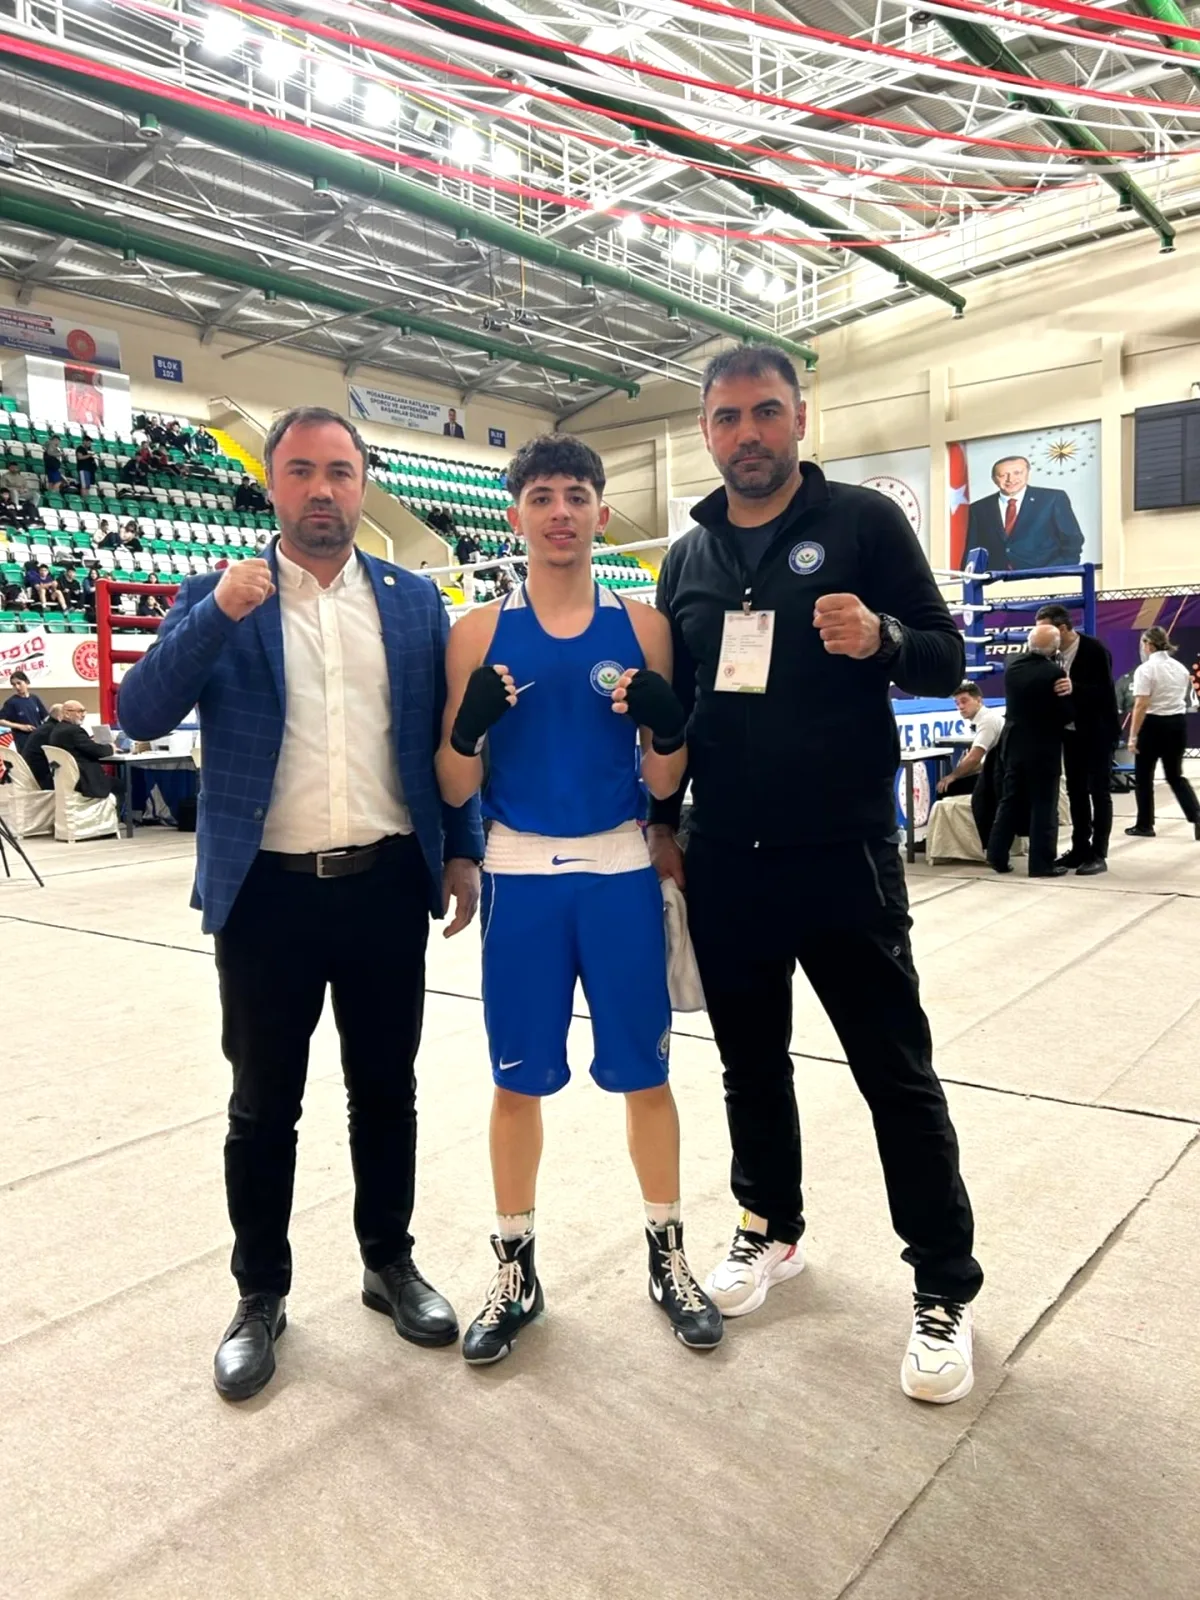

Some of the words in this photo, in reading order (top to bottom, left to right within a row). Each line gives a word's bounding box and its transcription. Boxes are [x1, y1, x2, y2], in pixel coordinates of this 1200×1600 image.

[157, 359, 178, 370] BLOK
[162, 370, 175, 378] 102
[920, 719, 965, 748] BOKS
